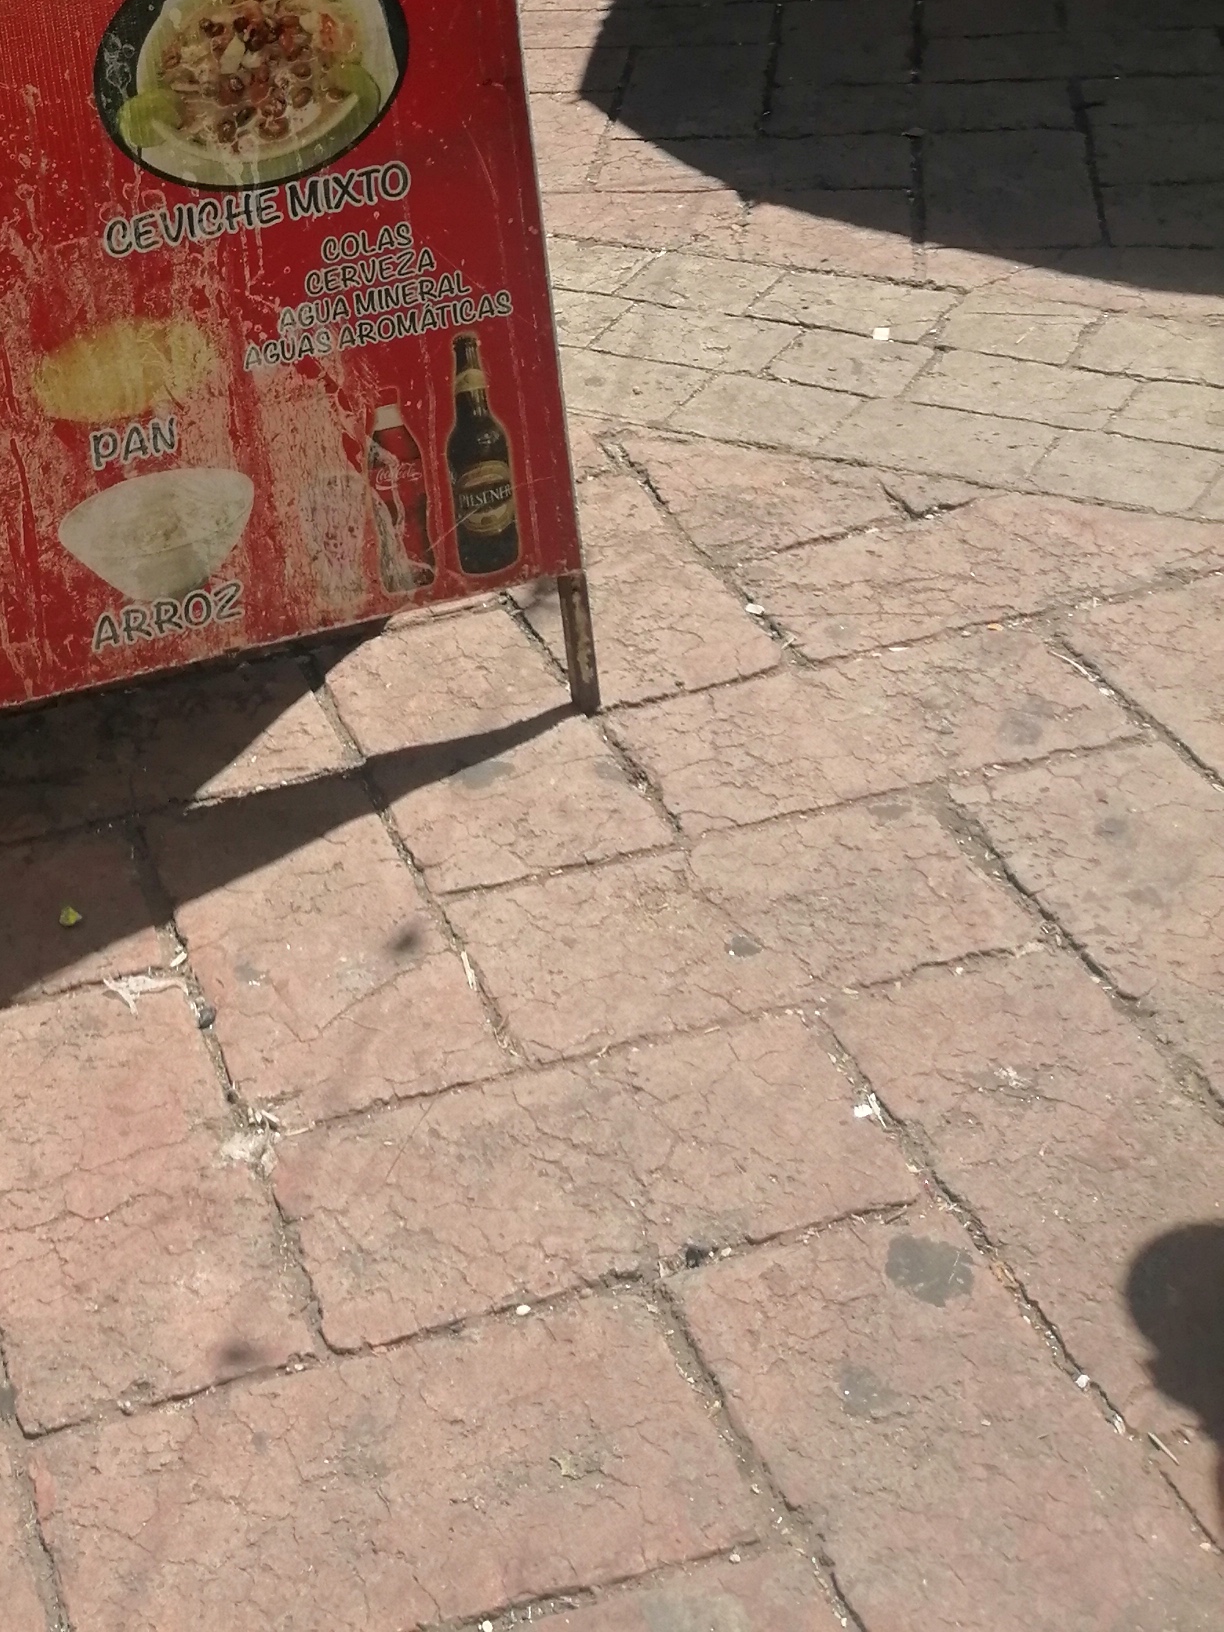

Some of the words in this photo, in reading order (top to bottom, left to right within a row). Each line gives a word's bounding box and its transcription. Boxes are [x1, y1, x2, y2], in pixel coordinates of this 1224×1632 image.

[104, 187, 283, 257] CEVICHE
[286, 162, 411, 220] MIXTO
[305, 248, 435, 296] CERVEZA
[322, 222, 413, 262] COLAS
[243, 331, 334, 371] AGUAS
[338, 290, 514, 351] AROMÁTICAS
[277, 296, 351, 334] AGUA
[354, 270, 472, 317] MINERAL
[90, 417, 177, 470] PAN
[92, 581, 244, 651] ARROZ
